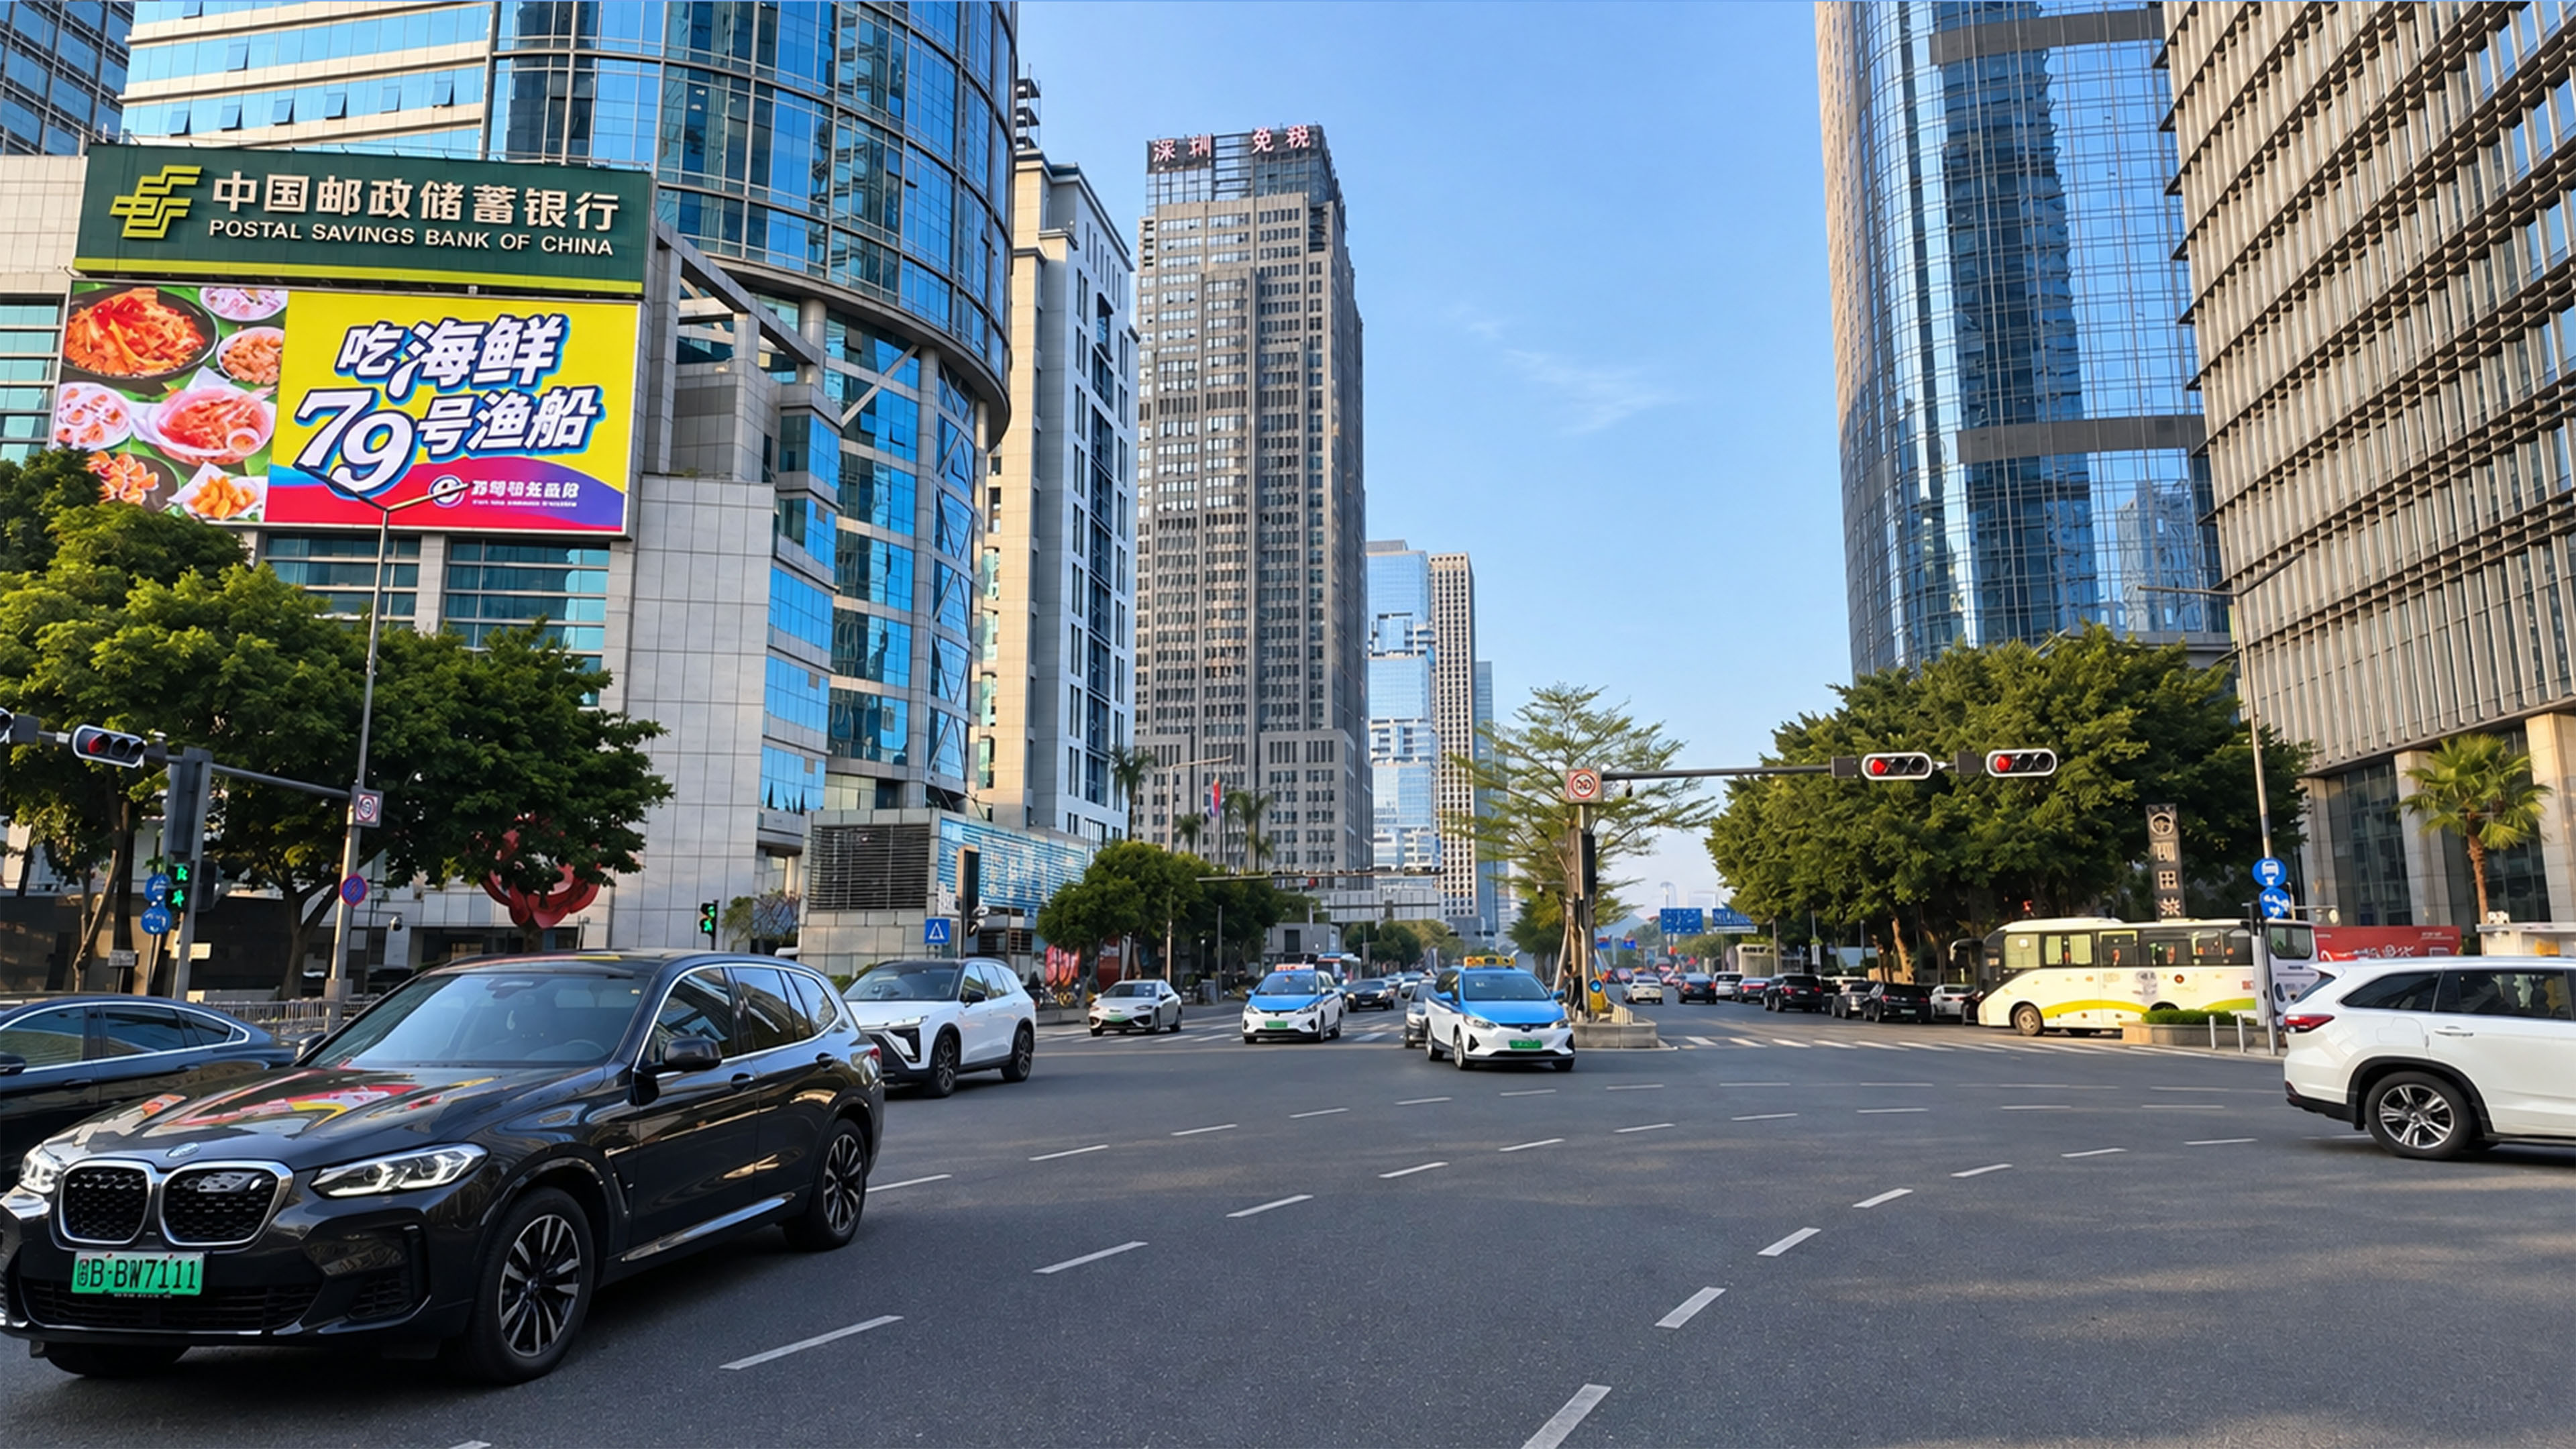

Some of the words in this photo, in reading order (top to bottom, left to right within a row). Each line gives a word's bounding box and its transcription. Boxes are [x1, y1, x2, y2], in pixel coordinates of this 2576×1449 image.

[213, 170, 619, 231] 中国邮政储蓄银行
[209, 219, 302, 240] POSTAL
[311, 223, 415, 245] SAVINGS
[425, 229, 490, 248] BANK
[500, 233, 531, 250] OF
[541, 235, 613, 256] CHINA
[335, 313, 565, 398] 吃海鲜
